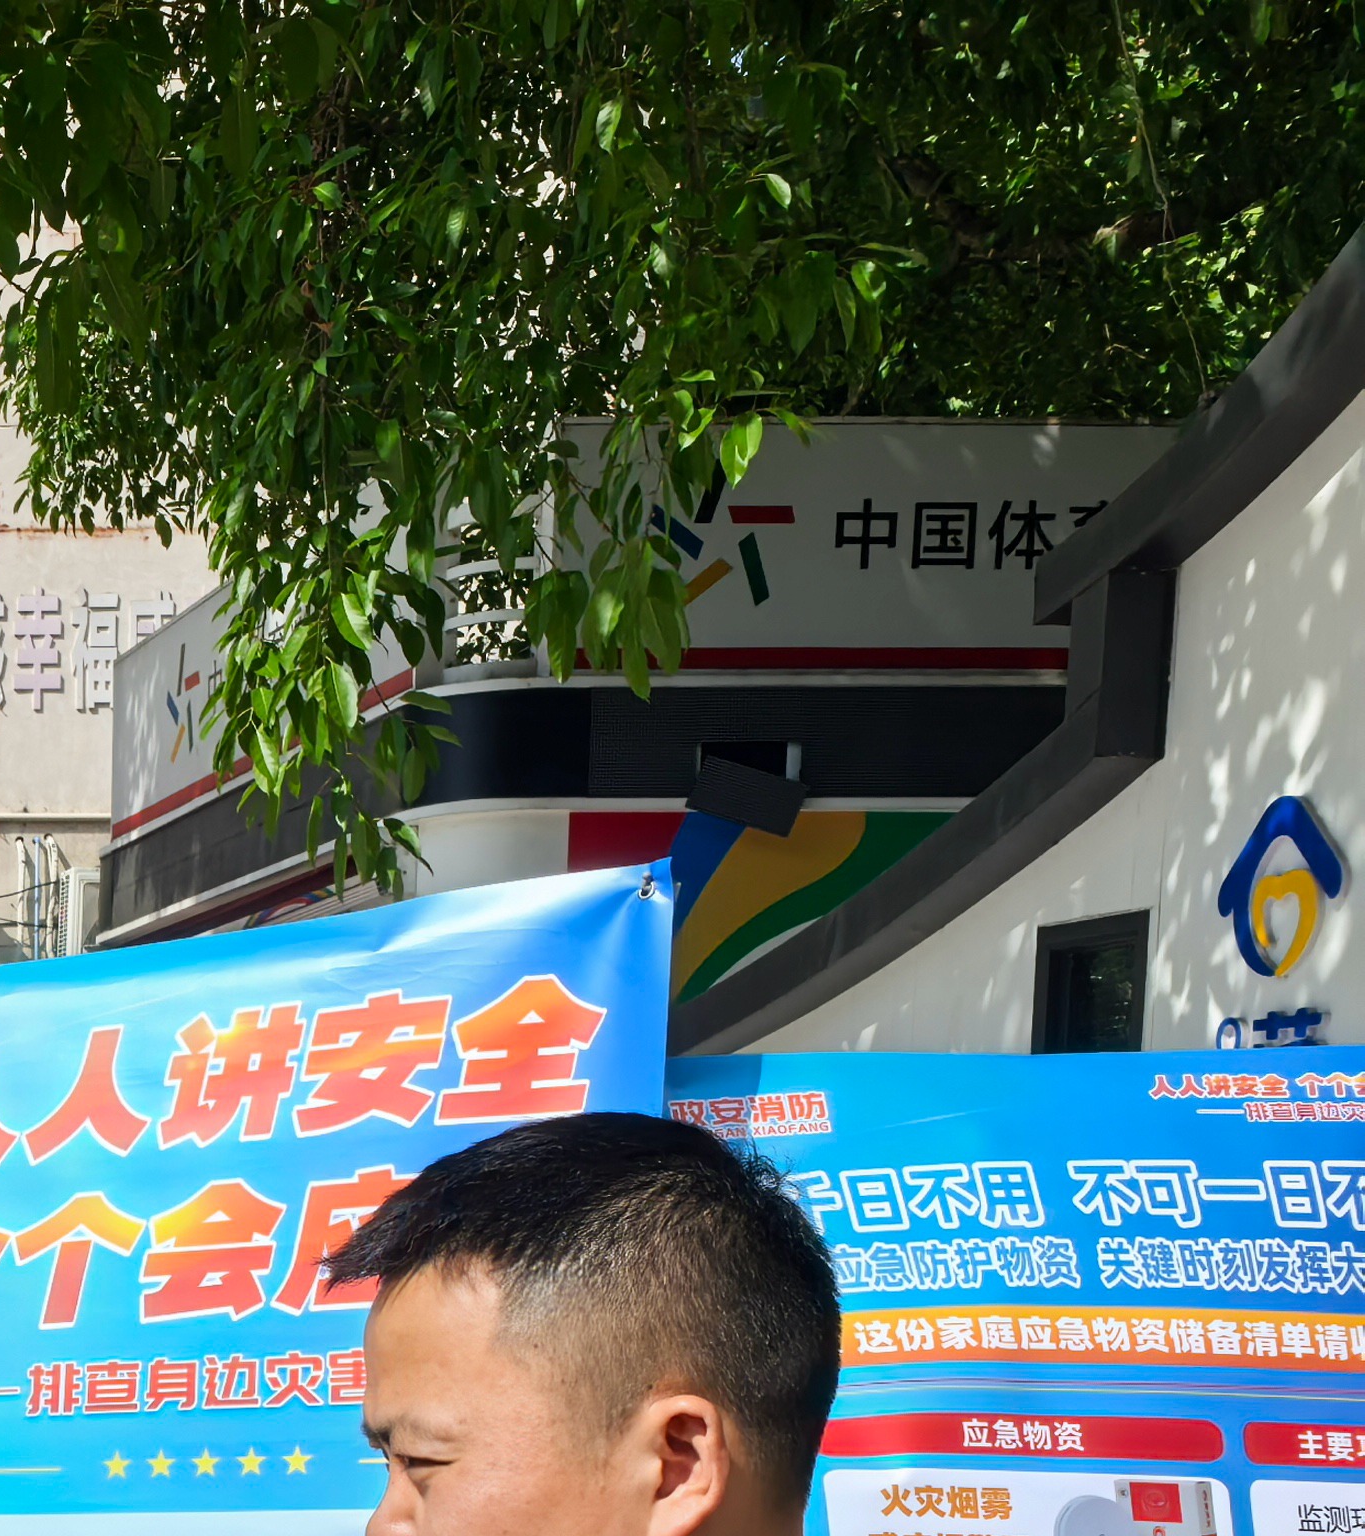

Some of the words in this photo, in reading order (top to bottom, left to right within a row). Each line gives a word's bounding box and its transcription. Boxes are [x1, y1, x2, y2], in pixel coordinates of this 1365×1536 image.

[835, 498, 1108, 570] 中国体
[1151, 1073, 1289, 1099] 人人讲安全
[670, 1092, 828, 1126] 政安消防
[753, 1121, 830, 1136] XIAOFANG
[833, 1236, 1081, 1292] 应急防护物资
[1097, 1237, 1365, 1295] 关键时刻发挥大
[961, 1419, 1084, 1451] 应急物资
[1298, 1430, 1365, 1461] 主要
[879, 1484, 1013, 1520] 火灾烟雾
